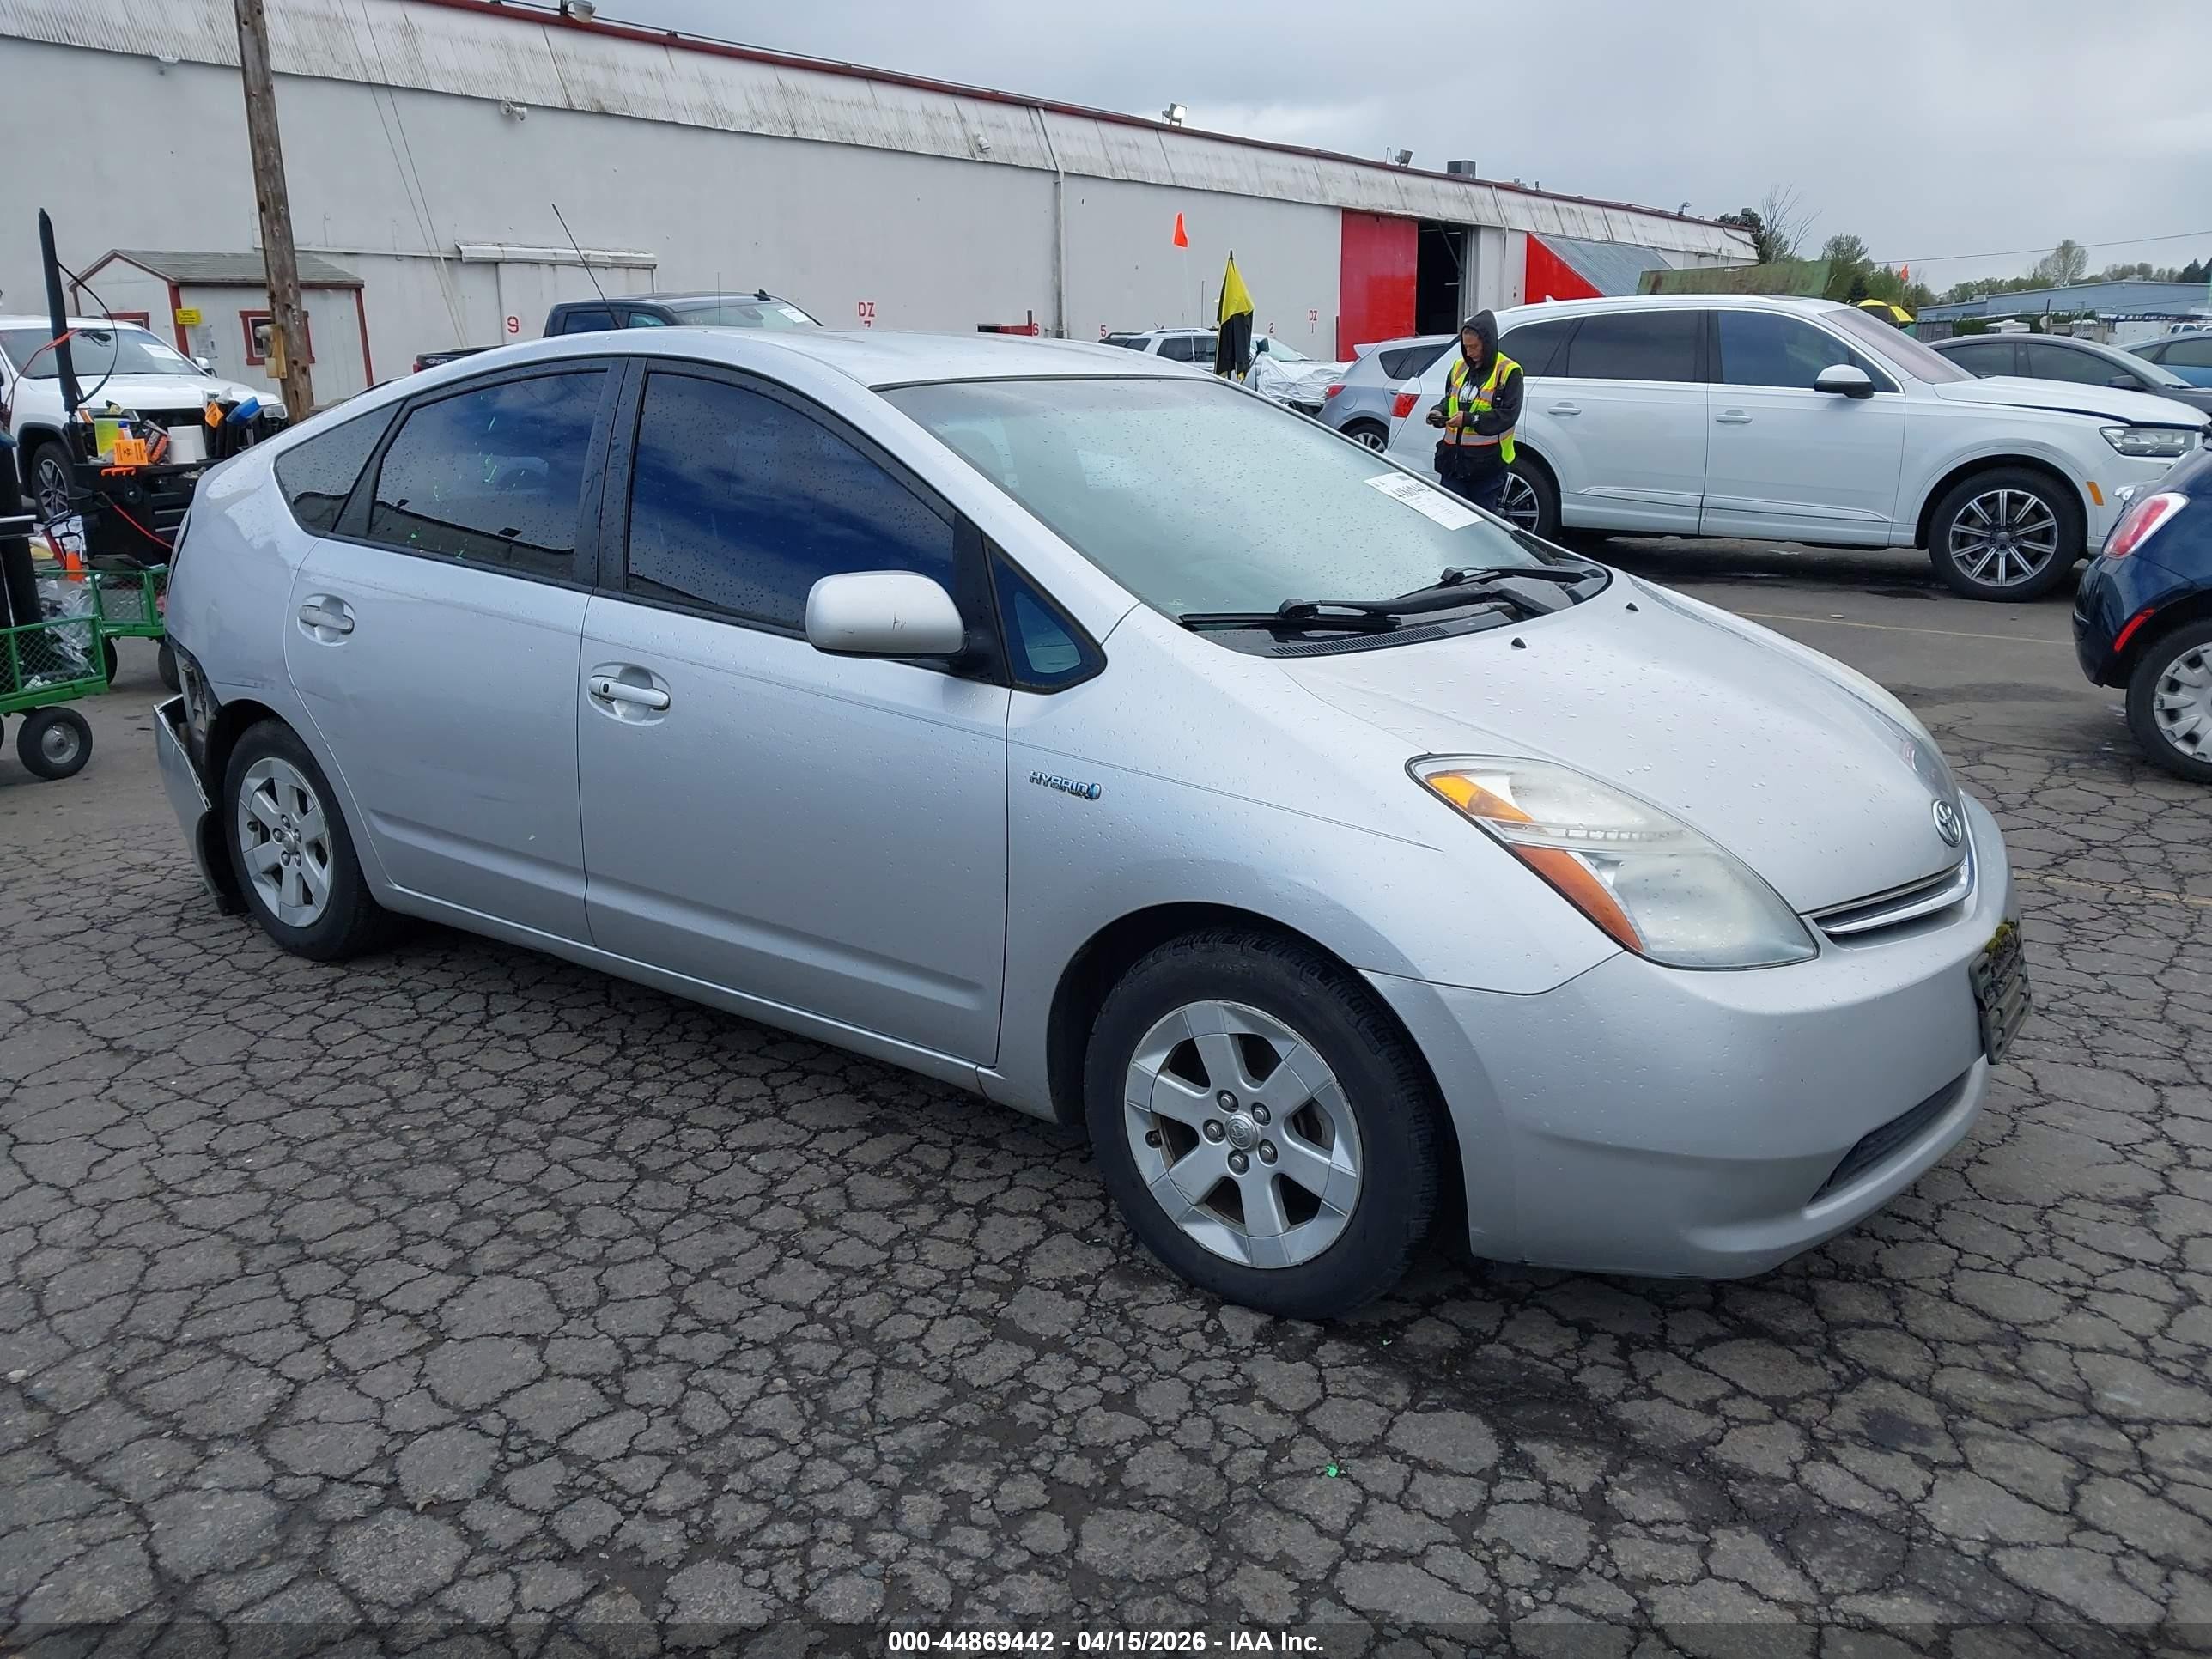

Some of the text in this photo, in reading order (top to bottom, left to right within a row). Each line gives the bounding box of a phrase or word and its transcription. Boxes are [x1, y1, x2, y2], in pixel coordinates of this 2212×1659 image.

[858, 301, 876, 318] DZ
[1309, 310, 1318, 322] DZ
[507, 315, 520, 334] 9
[1032, 322, 1040, 337] 6
[1100, 324, 1108, 337] 5
[1269, 322, 1275, 334] 2
[1029, 770, 1090, 798] HYBRID
